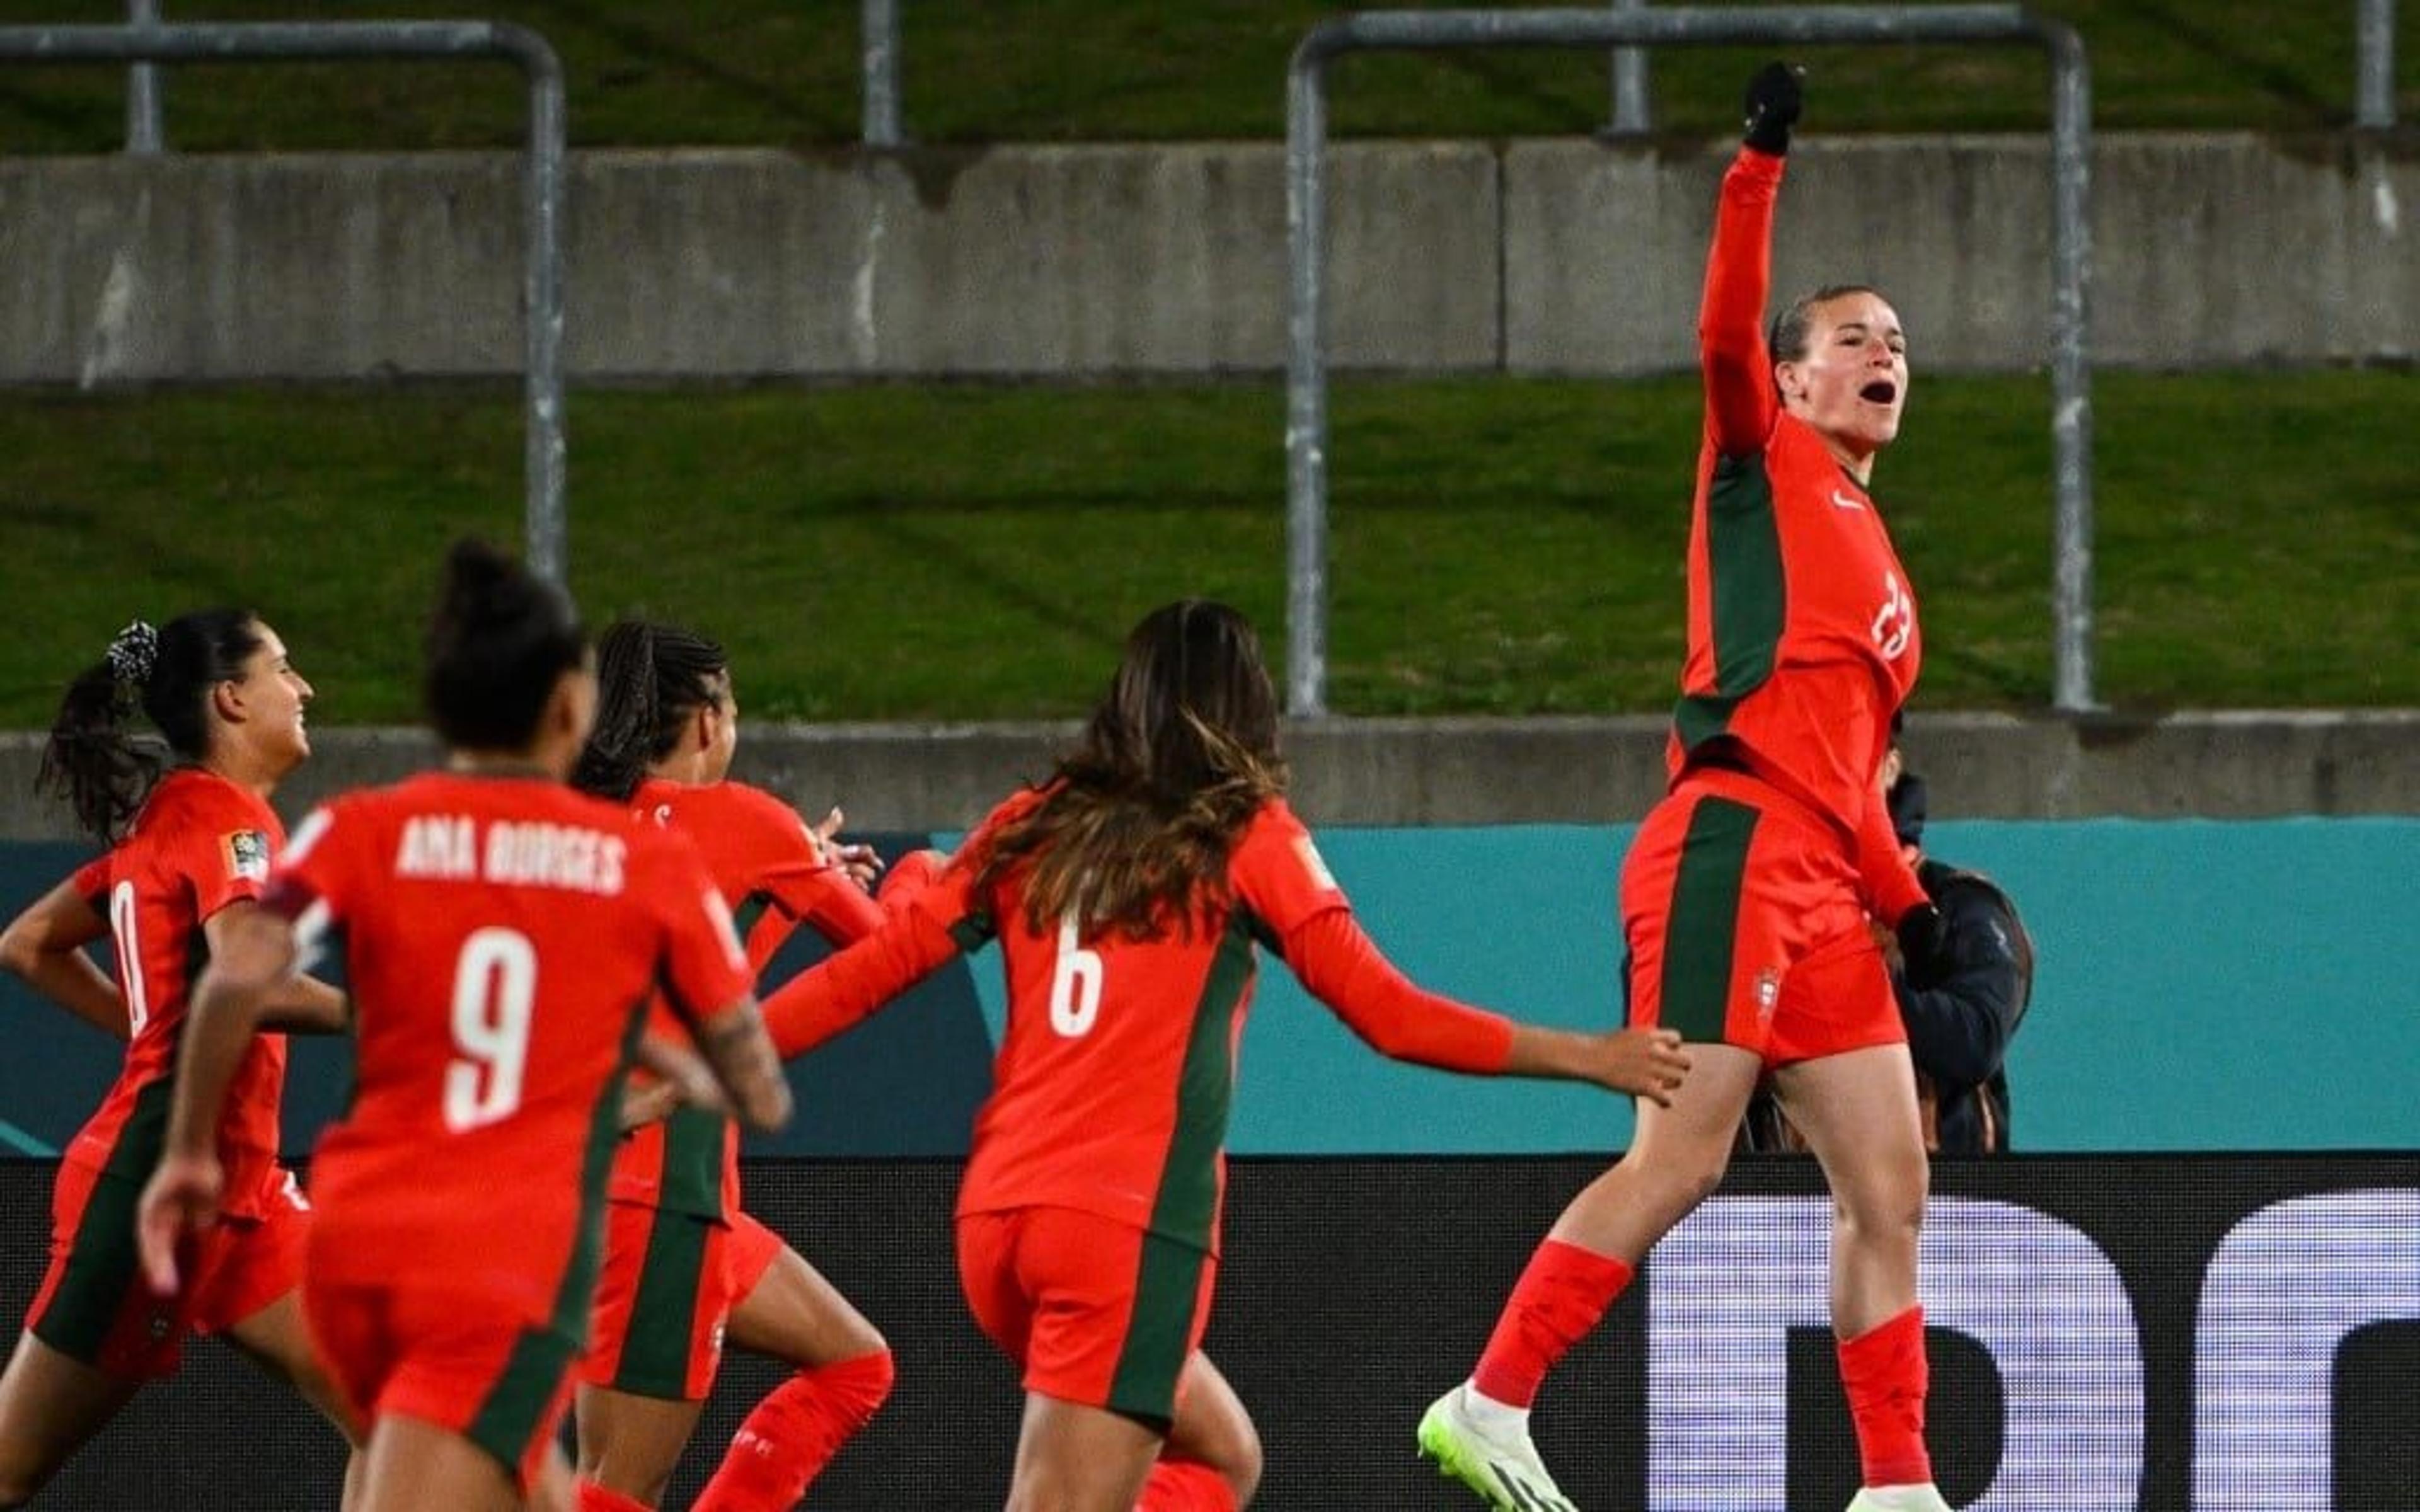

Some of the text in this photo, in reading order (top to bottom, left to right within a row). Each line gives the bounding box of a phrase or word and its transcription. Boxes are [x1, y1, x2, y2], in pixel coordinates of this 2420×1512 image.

[1871, 570, 1911, 660] 23
[396, 813, 628, 897] ANA BORGES
[1049, 907, 1103, 1037] 6
[446, 925, 536, 1133] 9
